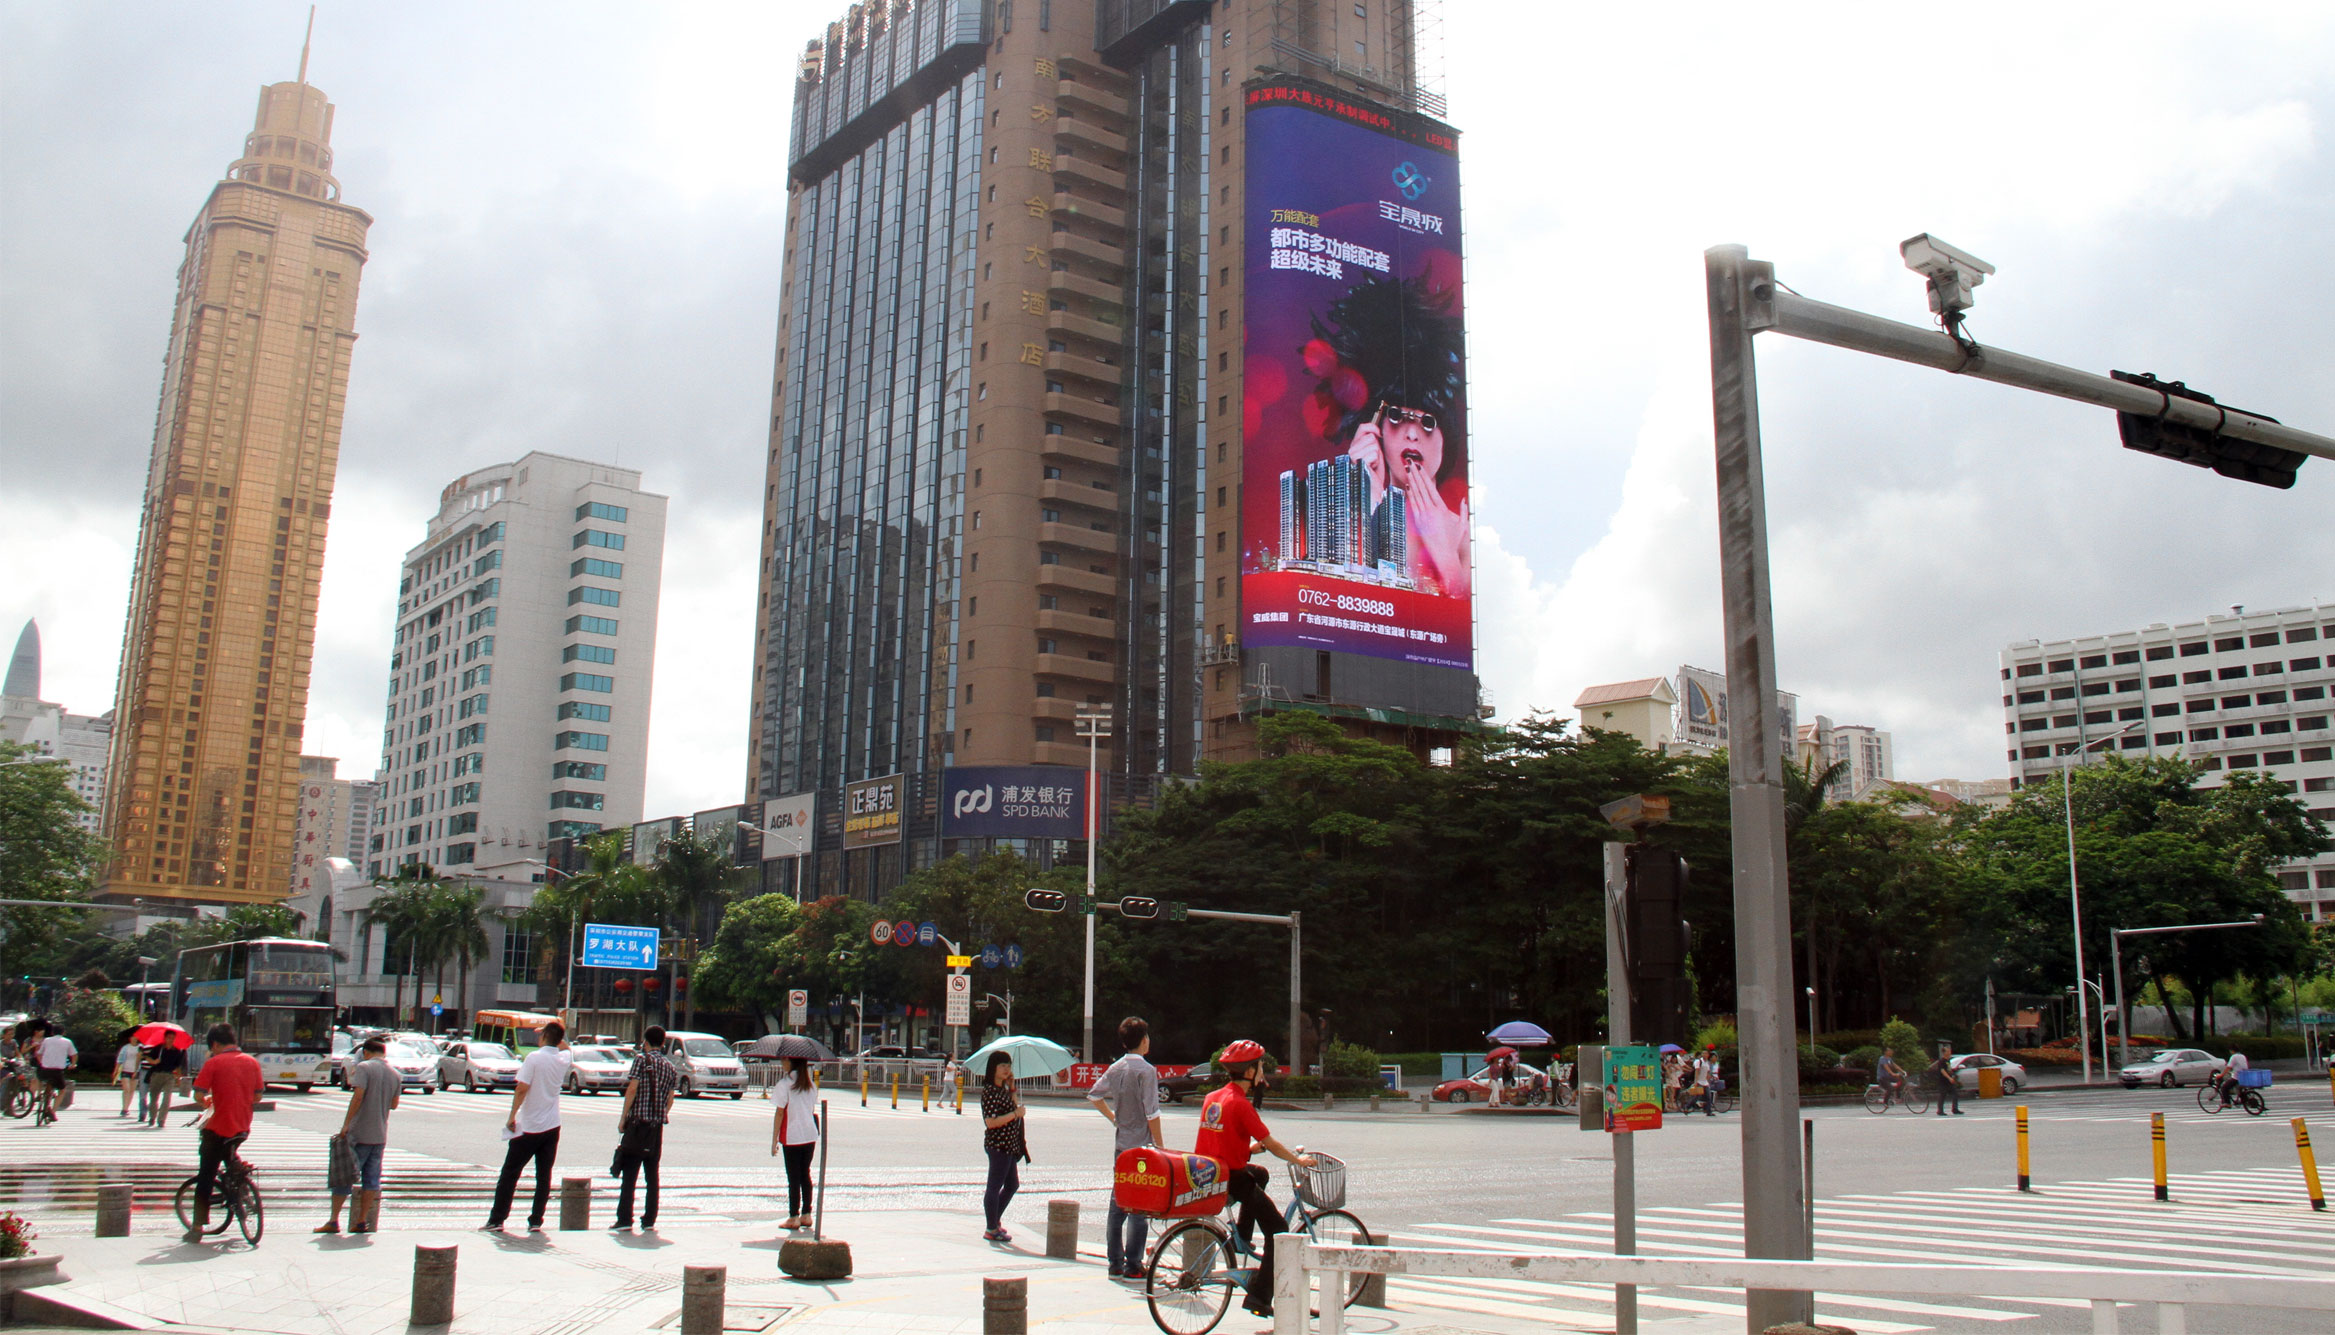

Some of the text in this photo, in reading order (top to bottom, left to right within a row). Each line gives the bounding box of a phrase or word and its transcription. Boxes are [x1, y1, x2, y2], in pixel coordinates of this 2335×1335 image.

[1021, 58, 1055, 367] 南方联合大酒店
[1270, 208, 1320, 229] 万能配套
[1270, 227, 1390, 273] 都市多功能配套
[1270, 249, 1343, 280] 超级未来
[1298, 588, 1395, 617] 0762-8839888
[1001, 785, 1074, 805] 浦发银行
[770, 812, 793, 830] AGFA
[1002, 804, 1071, 819] SPD BANK
[876, 925, 889, 938] 60
[589, 938, 638, 952] 罗湖大队
